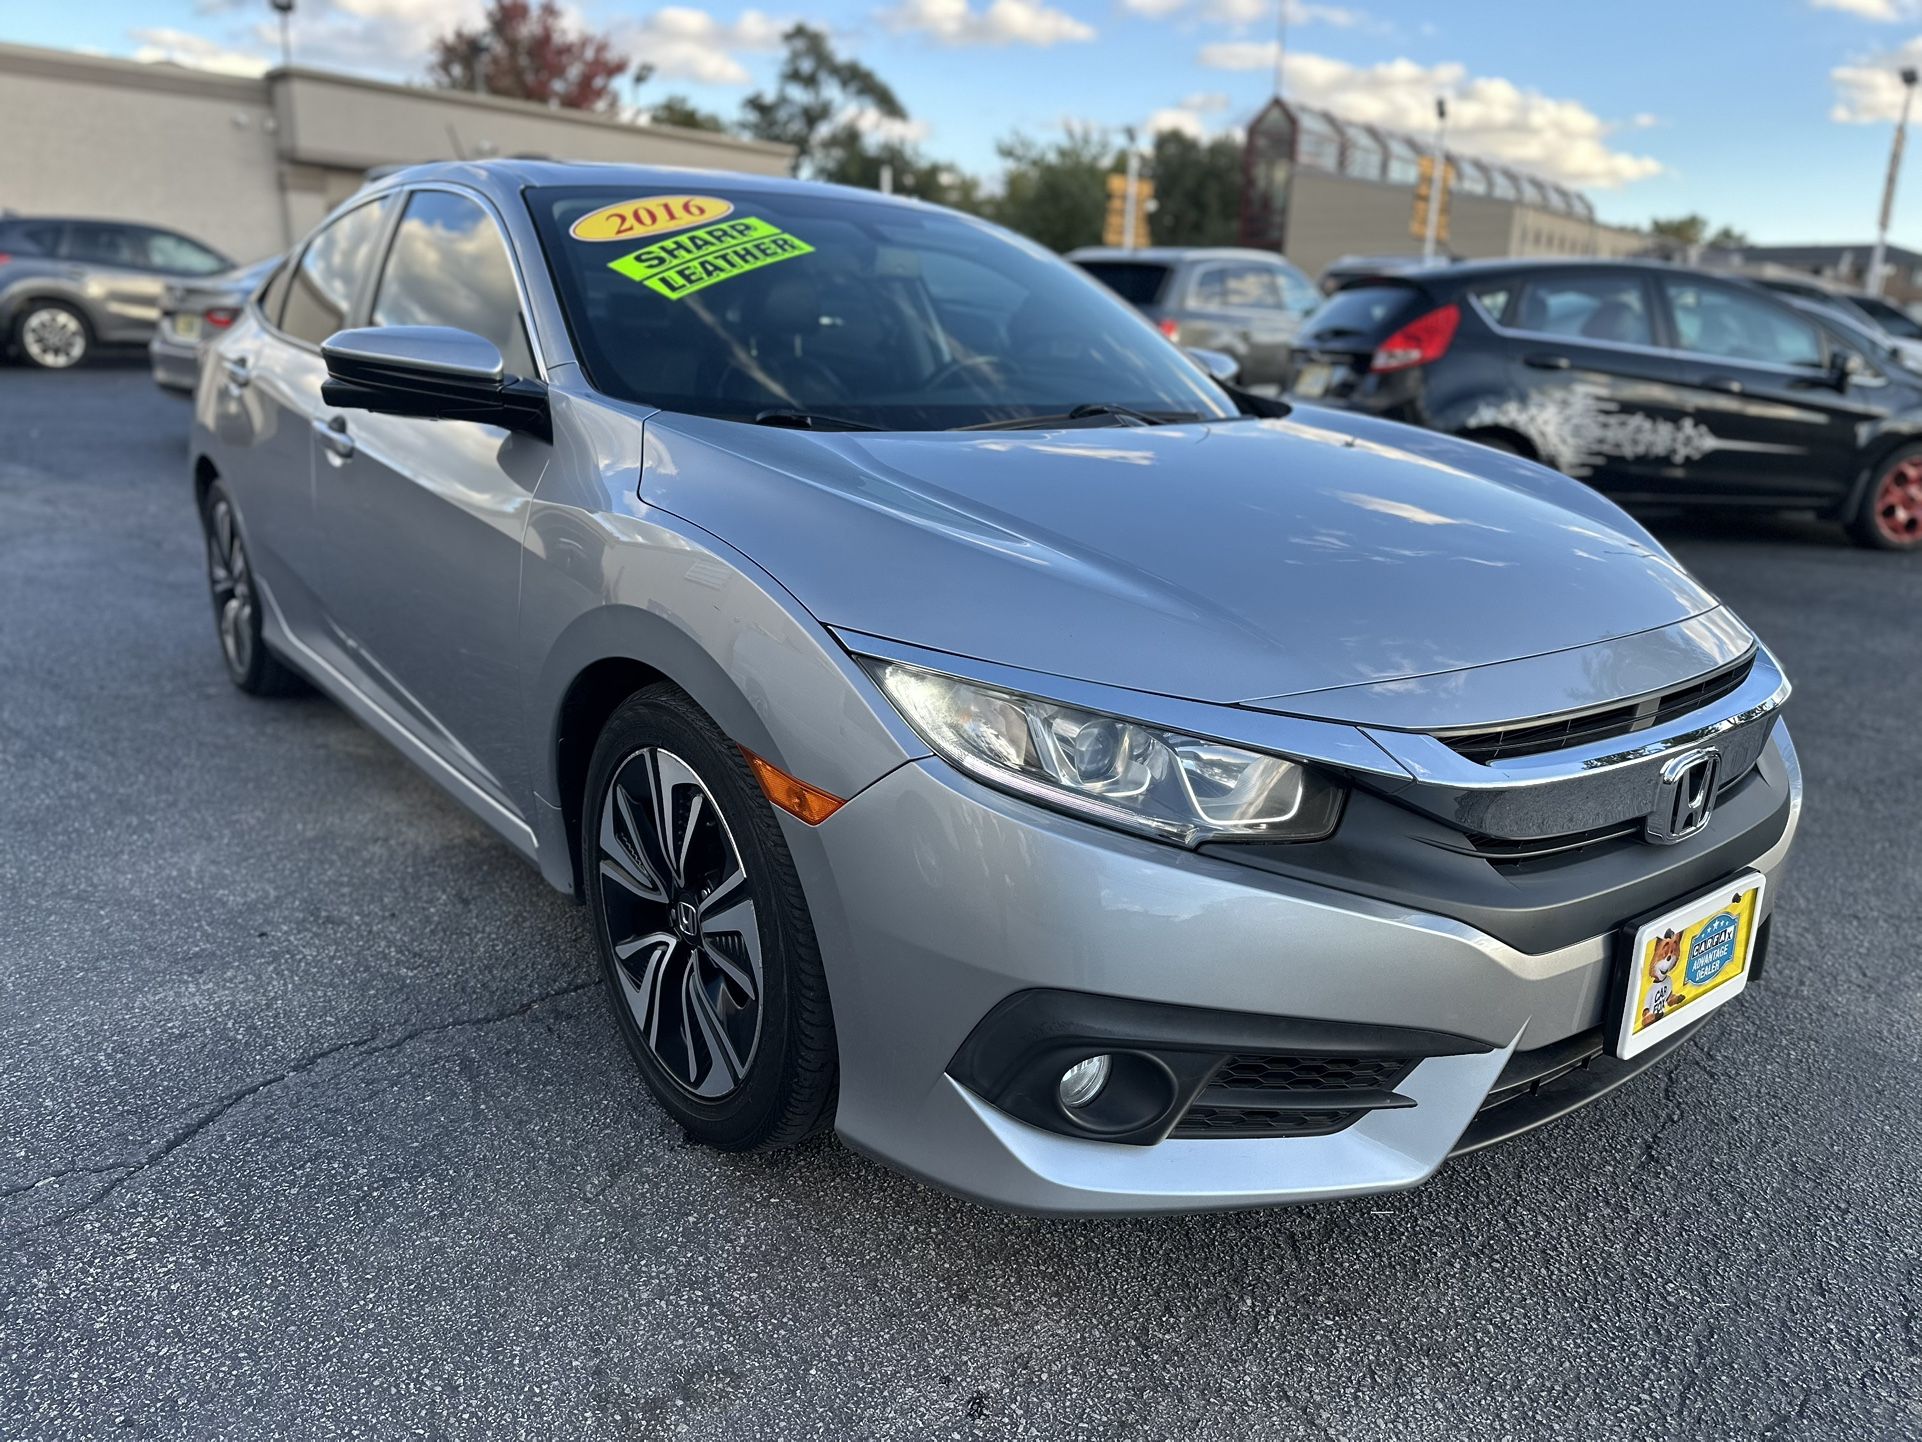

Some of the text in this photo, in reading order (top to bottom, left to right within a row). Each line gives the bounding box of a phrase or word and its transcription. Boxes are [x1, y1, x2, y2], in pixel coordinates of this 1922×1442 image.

[605, 198, 707, 235] 2016
[633, 221, 757, 269] SHARP
[659, 237, 799, 293] LEATHER
[1693, 930, 1733, 957] CARFAX
[1692, 944, 1729, 972] ADVANTAGE
[1696, 960, 1720, 981] DEALER
[1654, 985, 1668, 1003] CAR
